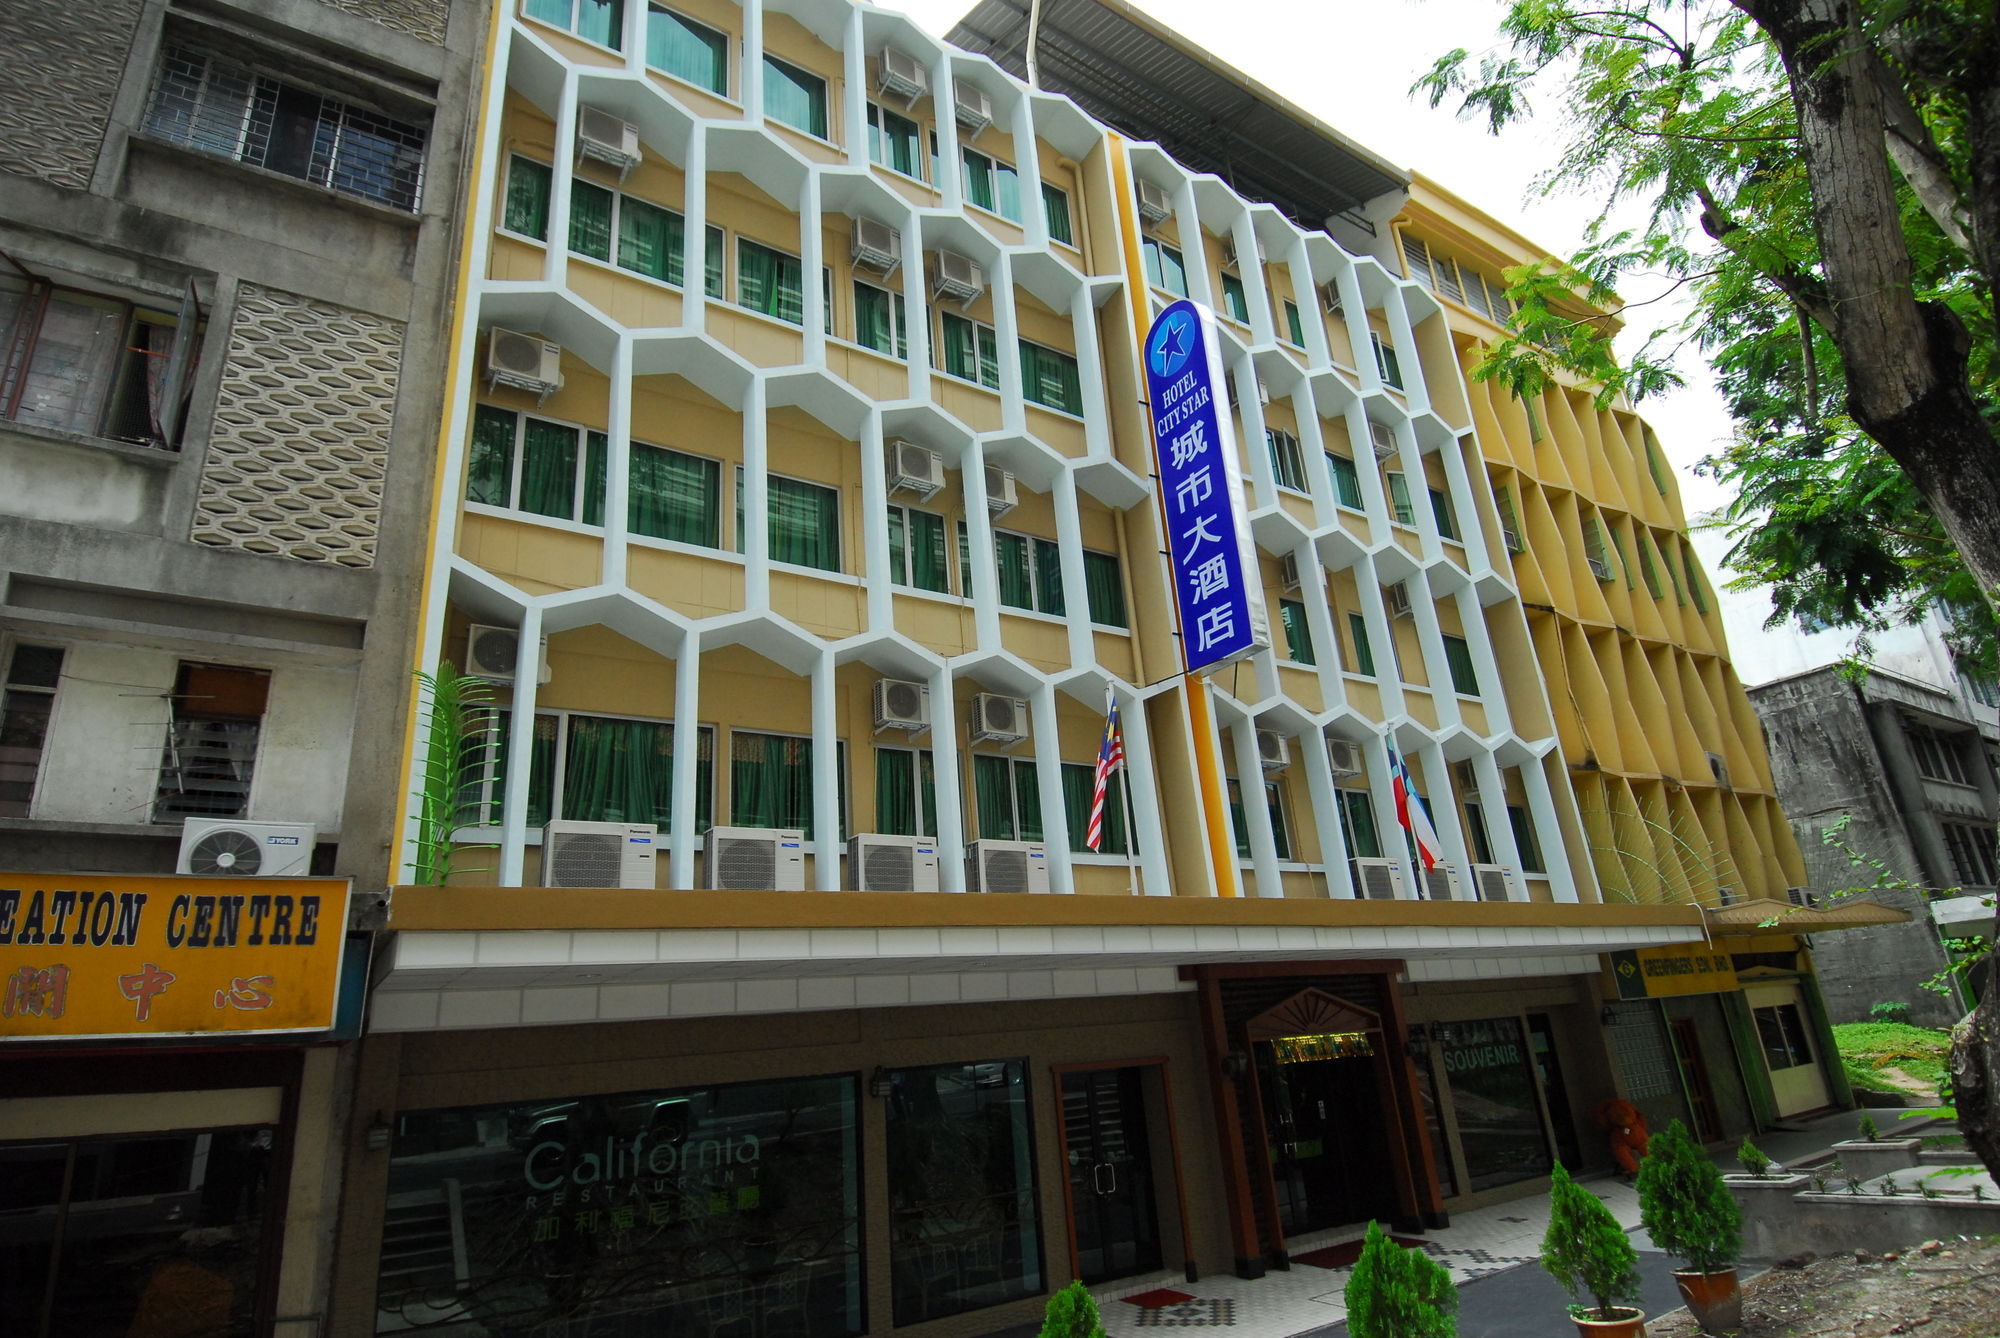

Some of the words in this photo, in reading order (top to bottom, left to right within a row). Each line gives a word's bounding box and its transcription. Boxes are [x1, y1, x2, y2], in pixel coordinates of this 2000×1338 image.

[1157, 406, 1180, 437] CITY
[1181, 386, 1210, 419] STAR
[1162, 370, 1197, 409] HOTEL
[1169, 419, 1236, 653] 城市大酒店
[166, 893, 321, 949] CENTRE
[1444, 1044, 1520, 1072] SOUVENIR
[524, 1132, 760, 1190] California
[526, 1167, 760, 1210] RESTAURANT
